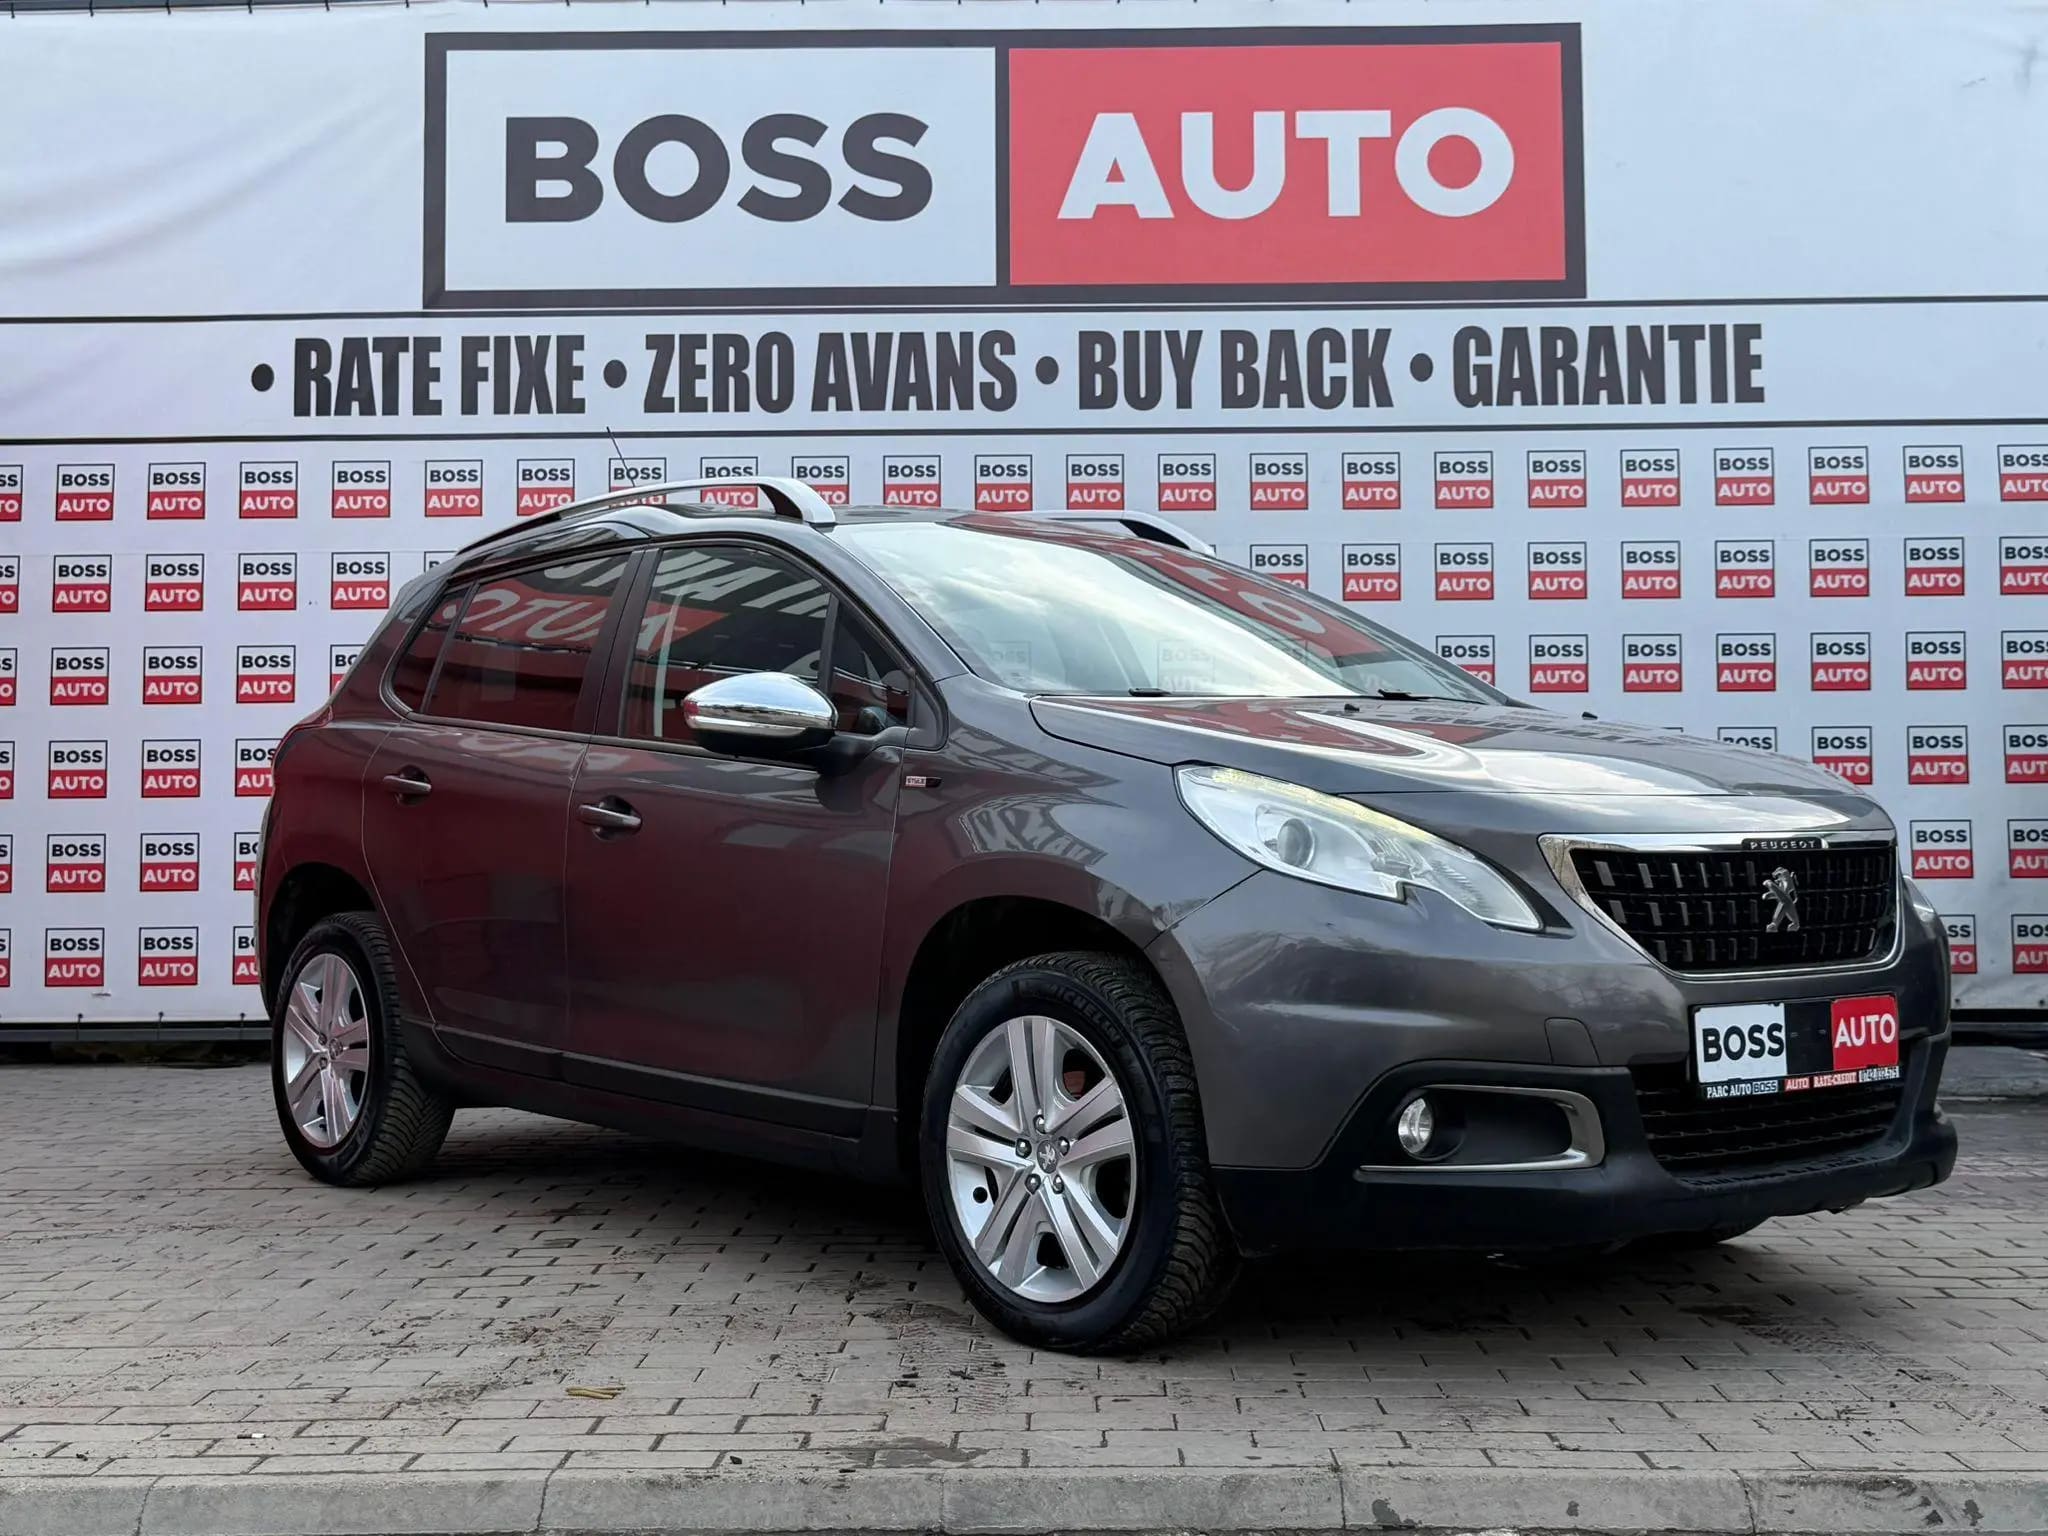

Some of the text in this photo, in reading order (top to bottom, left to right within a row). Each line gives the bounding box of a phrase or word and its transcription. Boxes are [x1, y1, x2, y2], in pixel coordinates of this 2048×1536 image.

[506, 107, 1514, 223] BOSS AUTO
[294, 323, 1765, 417] RATE FIXE ZERO AVANS BUY BACK GARANTIE
[1440, 461, 1489, 474] BOSS
[1533, 460, 1582, 473] BOSS
[1626, 459, 1675, 472] BOSS
[1722, 458, 1769, 470] BOSS
[1816, 456, 1863, 469] BOSS
[1910, 455, 1958, 467] BOSS
[613, 467, 662, 480] BOSS
[705, 466, 754, 478] BOSS
[796, 466, 845, 478] BOSS
[888, 465, 936, 477] BOSS
[980, 464, 1027, 477] BOSS
[1072, 464, 1119, 476] BOSS
[1164, 464, 1211, 475] BOSS
[1256, 463, 1303, 475] BOSS
[1348, 462, 1395, 474] BOSS
[62, 474, 109, 486] BOSS
[153, 472, 200, 485] BOSS
[245, 471, 292, 483] BOSS
[338, 471, 385, 483] BOSS
[430, 470, 478, 482] BOSS
[522, 469, 570, 481] BOSS
[1347, 488, 1397, 500] AUTO
[1441, 487, 1490, 499] AUTO
[1534, 486, 1583, 498] AUTO
[1627, 485, 1677, 497] AUTO
[1721, 483, 1773, 496] AUTO
[1815, 482, 1868, 495] AUTO
[1909, 481, 1962, 494] AUTO
[520, 494, 572, 507] AUTO
[704, 490, 755, 505] AUTO
[820, 491, 846, 504] TO
[886, 490, 938, 504] AUTO
[979, 490, 1029, 503] AUTO
[1070, 490, 1121, 502] AUTO
[1163, 489, 1213, 502] AUTO
[1255, 488, 1304, 501] AUTO
[59, 499, 110, 512] AUTO
[151, 498, 201, 510] AUTO
[243, 497, 294, 510] AUTO
[335, 496, 386, 509] AUTO
[428, 495, 479, 508] AUTO
[1255, 554, 1304, 566] BOSS
[1348, 553, 1395, 565] BOSS
[1442, 553, 1488, 565] BOSS
[1534, 552, 1581, 564] BOSS
[1627, 551, 1675, 563] BOSS
[1721, 550, 1769, 562] BOSS
[1815, 549, 1864, 561] BOSS
[1910, 548, 1959, 560] BOSS
[59, 565, 106, 577] BOSS
[151, 564, 199, 576] BOSS
[244, 563, 291, 575] BOSS
[337, 562, 384, 574] BOSS
[1347, 579, 1397, 592] AUTO
[1441, 578, 1490, 591] AUTO
[1533, 578, 1584, 590] AUTO
[1626, 577, 1677, 590] AUTO
[1720, 576, 1773, 589] AUTO
[1814, 575, 1867, 588] AUTO
[1909, 574, 1962, 587] AUTO
[56, 590, 107, 603] AUTO
[148, 589, 199, 602] AUTO
[241, 588, 292, 601] AUTO
[335, 587, 385, 600] AUTO
[1441, 645, 1490, 658] BOSS
[1535, 645, 1583, 657] BOSS
[1629, 644, 1676, 656] BOSS
[1722, 643, 1770, 656] BOSS
[1817, 643, 1865, 655] BOSS
[1912, 642, 1961, 654] BOSS
[56, 657, 104, 670] BOSS
[149, 656, 197, 669] BOSS
[242, 655, 290, 668] BOSS
[1534, 670, 1585, 683] AUTO
[1628, 670, 1678, 683] AUTO
[1721, 669, 1774, 682] AUTO
[1816, 669, 1869, 681] AUTO
[1911, 668, 1964, 681] AUTO
[54, 683, 105, 696] AUTO
[146, 682, 197, 695] AUTO
[240, 681, 291, 694] AUTO
[1817, 736, 1867, 749] BOSS
[1913, 736, 1963, 748] BOSS
[2009, 735, 2048, 747] BOS
[54, 750, 102, 763] BOSS
[147, 749, 195, 762] BOSS
[241, 748, 276, 761] BOS
[1824, 762, 1869, 776] UTO
[1912, 762, 1965, 775] AUTO
[2008, 761, 2048, 774] AUT
[52, 776, 103, 789] AUTO
[145, 775, 196, 788] AUTO
[238, 774, 273, 788] AUT
[1917, 830, 1966, 842] BOSS
[2013, 829, 2048, 842] BOS
[52, 844, 100, 856] BOSS
[146, 843, 194, 856] BOSS
[1749, 841, 1816, 849] PEUGEOT
[1916, 856, 1969, 869] AUTO
[2013, 856, 2048, 869] AUT
[50, 870, 101, 883] AUTO
[143, 869, 194, 882] AUTO
[1948, 924, 1971, 938] SS
[2017, 925, 2048, 937] BO
[51, 938, 99, 951] BOSS
[144, 937, 193, 950] BOSS
[1951, 950, 1974, 965] TO
[49, 964, 100, 977] AUTO
[142, 963, 193, 977] AUTO
[1702, 1013, 1896, 1063] BOSS AUTO
[1706, 1085, 1729, 1099] PARC
[1729, 1083, 1752, 1096] AUTO
[1752, 1081, 1777, 1093] BOSS
